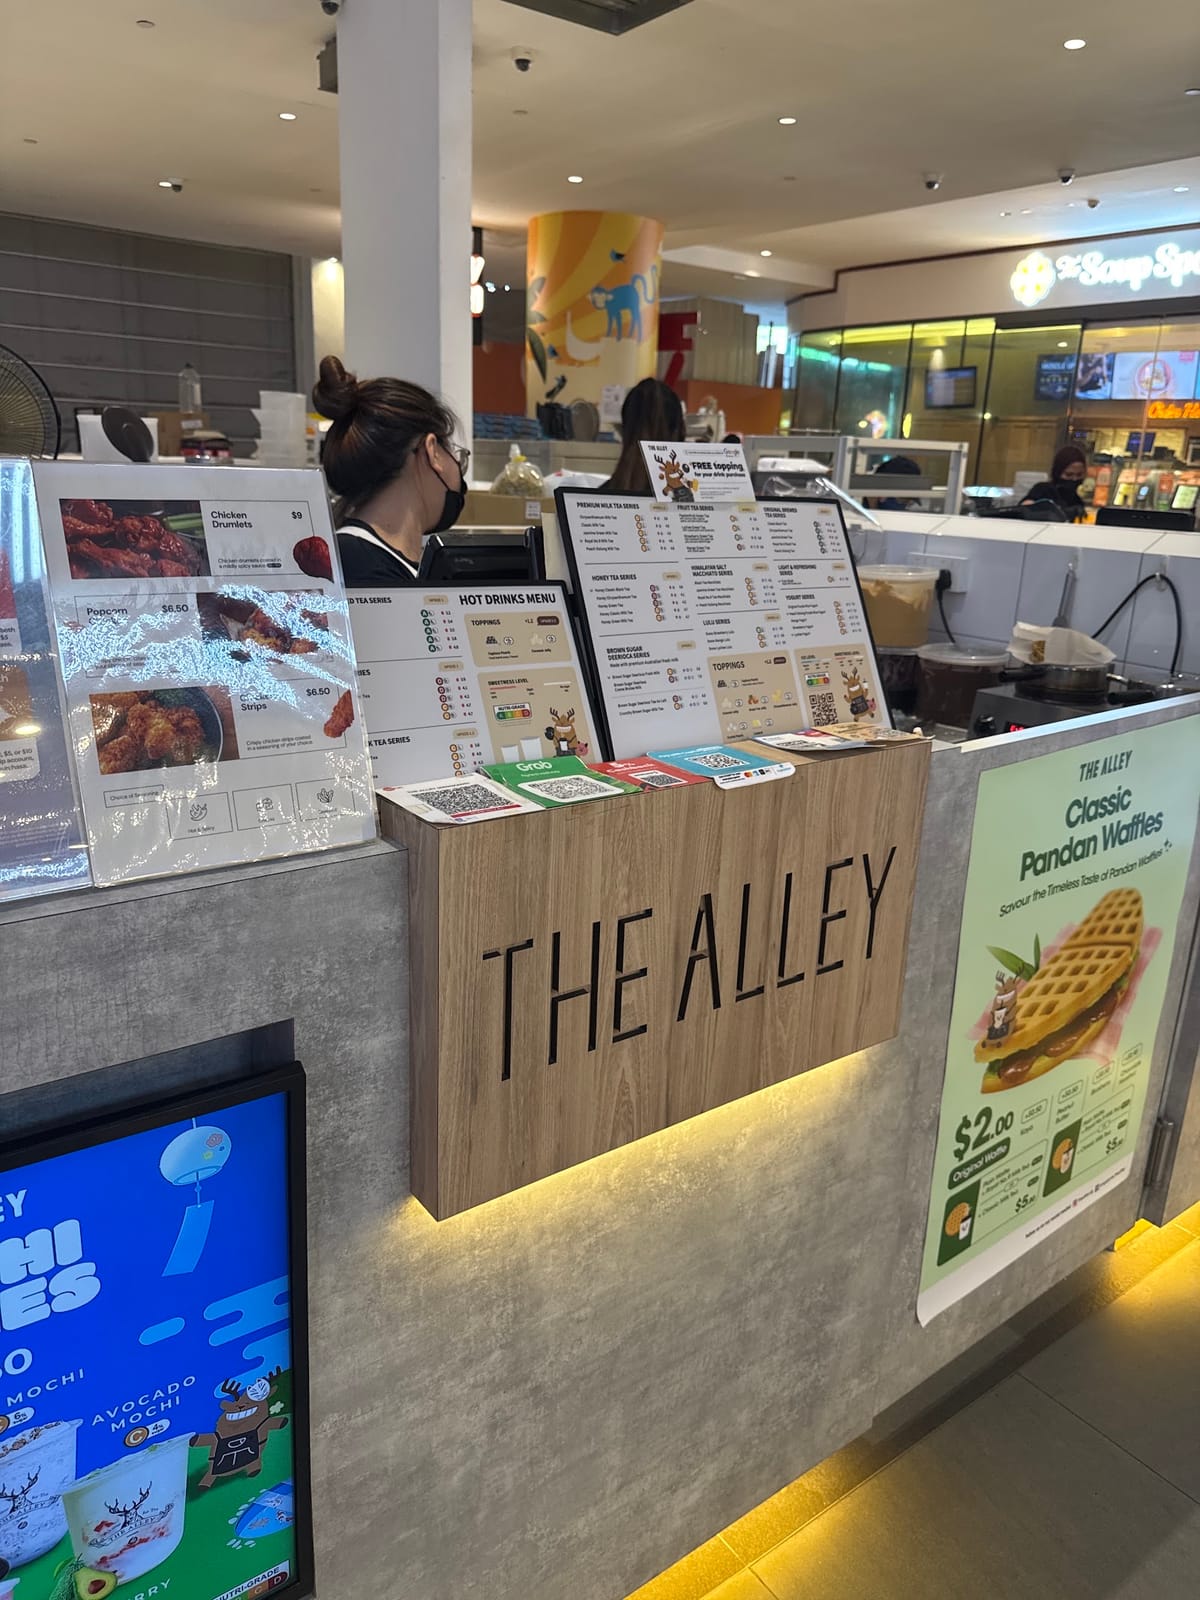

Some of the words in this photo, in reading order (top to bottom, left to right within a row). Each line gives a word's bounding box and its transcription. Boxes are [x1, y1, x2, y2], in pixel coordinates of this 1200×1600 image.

[1079, 251, 1154, 291] Soup
[692, 462, 713, 470] FREE
[713, 461, 744, 472] topping
[210, 510, 248, 519] Chicken
[291, 511, 302, 520] $9
[212, 520, 253, 528] Drumlets
[459, 594, 482, 606] HOT
[486, 594, 525, 604] DRINKS
[526, 593, 556, 604] MENU
[86, 608, 128, 616] Popcorn
[162, 604, 189, 614] $6.50
[712, 660, 745, 671] TOPPINGS
[306, 687, 331, 696] $6.50
[240, 703, 268, 712] Strips
[374, 738, 387, 746] TEA
[388, 736, 411, 744] SERIES
[516, 760, 552, 772] Grab
[1080, 760, 1100, 782] THE
[1100, 750, 1133, 776] ALLEY
[1065, 785, 1132, 828] Classic
[1020, 834, 1098, 882] Pandan
[1102, 811, 1164, 852] Waffles
[1000, 895, 1032, 918] Savour
[1032, 889, 1047, 902] the
[1048, 878, 1080, 897] Timeless
[1080, 872, 1100, 886] Taste
[1100, 868, 1109, 882] of
[1109, 860, 1138, 879] Pandan
[1138, 848, 1162, 869] Waffles
[482, 907, 654, 1081] THE
[676, 846, 897, 1022] ALLEY
[954, 1106, 1014, 1162] $2.00
[953, 1156, 985, 1182] Original
[985, 1145, 1008, 1166] Waffle
[0, 1262, 101, 1331] ES
[7, 1368, 85, 1407] MOCHI
[91, 1376, 196, 1426] AVOCADO
[110, 1396, 181, 1433] MOCHI
[129, 1430, 144, 1444] C
[128, 1578, 171, 1600] RRY
[213, 1566, 280, 1600] NUTRI-GRADE
[274, 1575, 282, 1585] D
